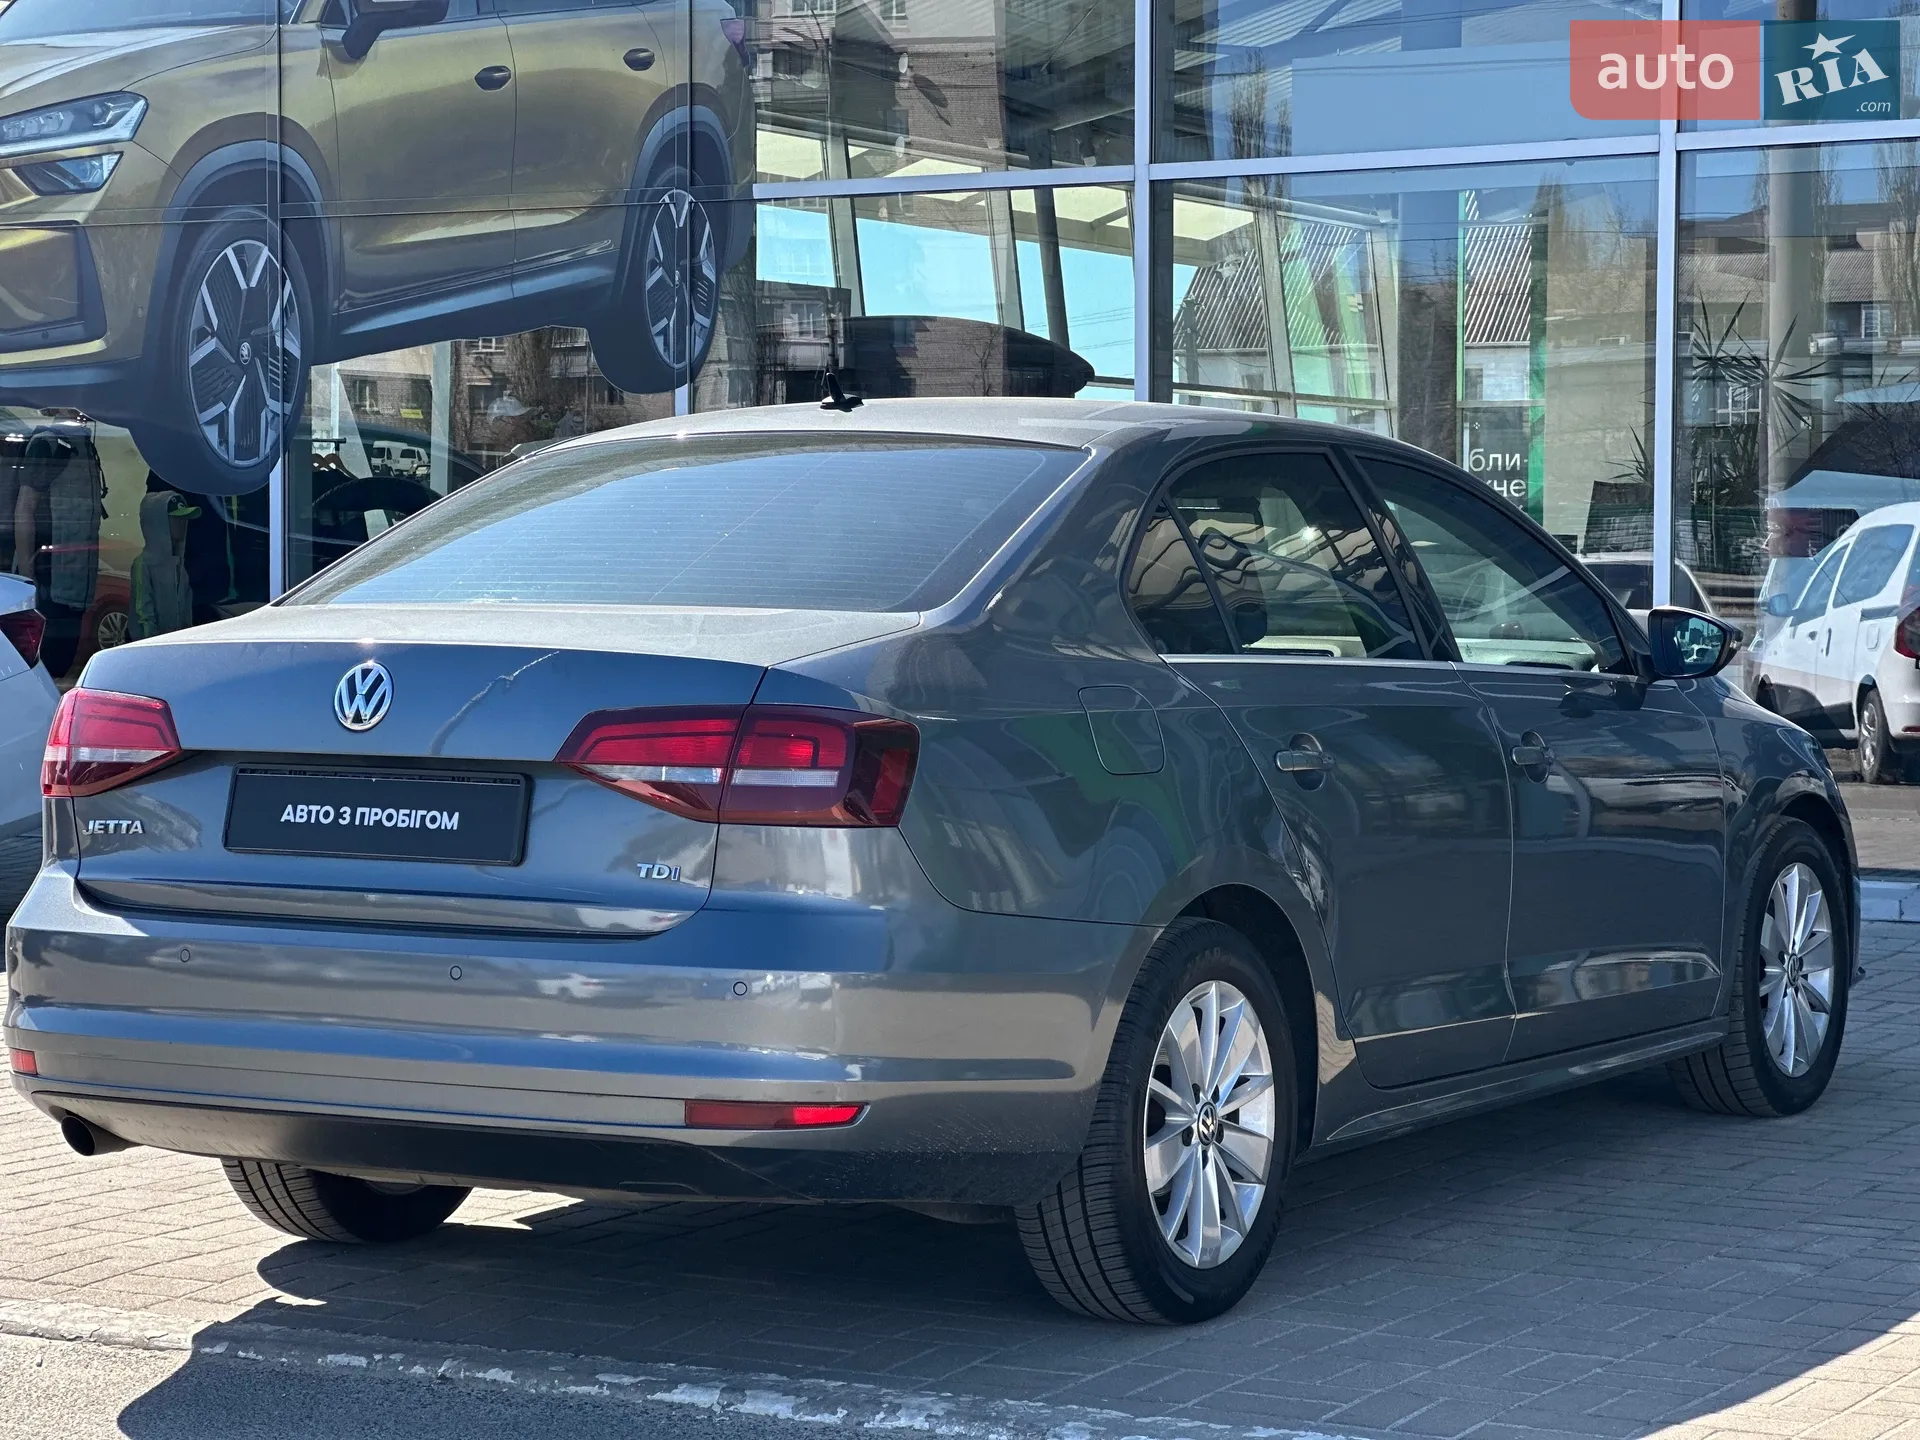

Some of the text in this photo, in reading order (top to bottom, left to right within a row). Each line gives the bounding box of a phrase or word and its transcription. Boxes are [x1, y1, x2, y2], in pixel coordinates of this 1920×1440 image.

[1486, 479, 1527, 497] че
[280, 804, 335, 824] АВТО
[354, 807, 460, 830] ПРОБІГОМ
[82, 820, 143, 835] JETTA
[637, 863, 680, 880] TDI
